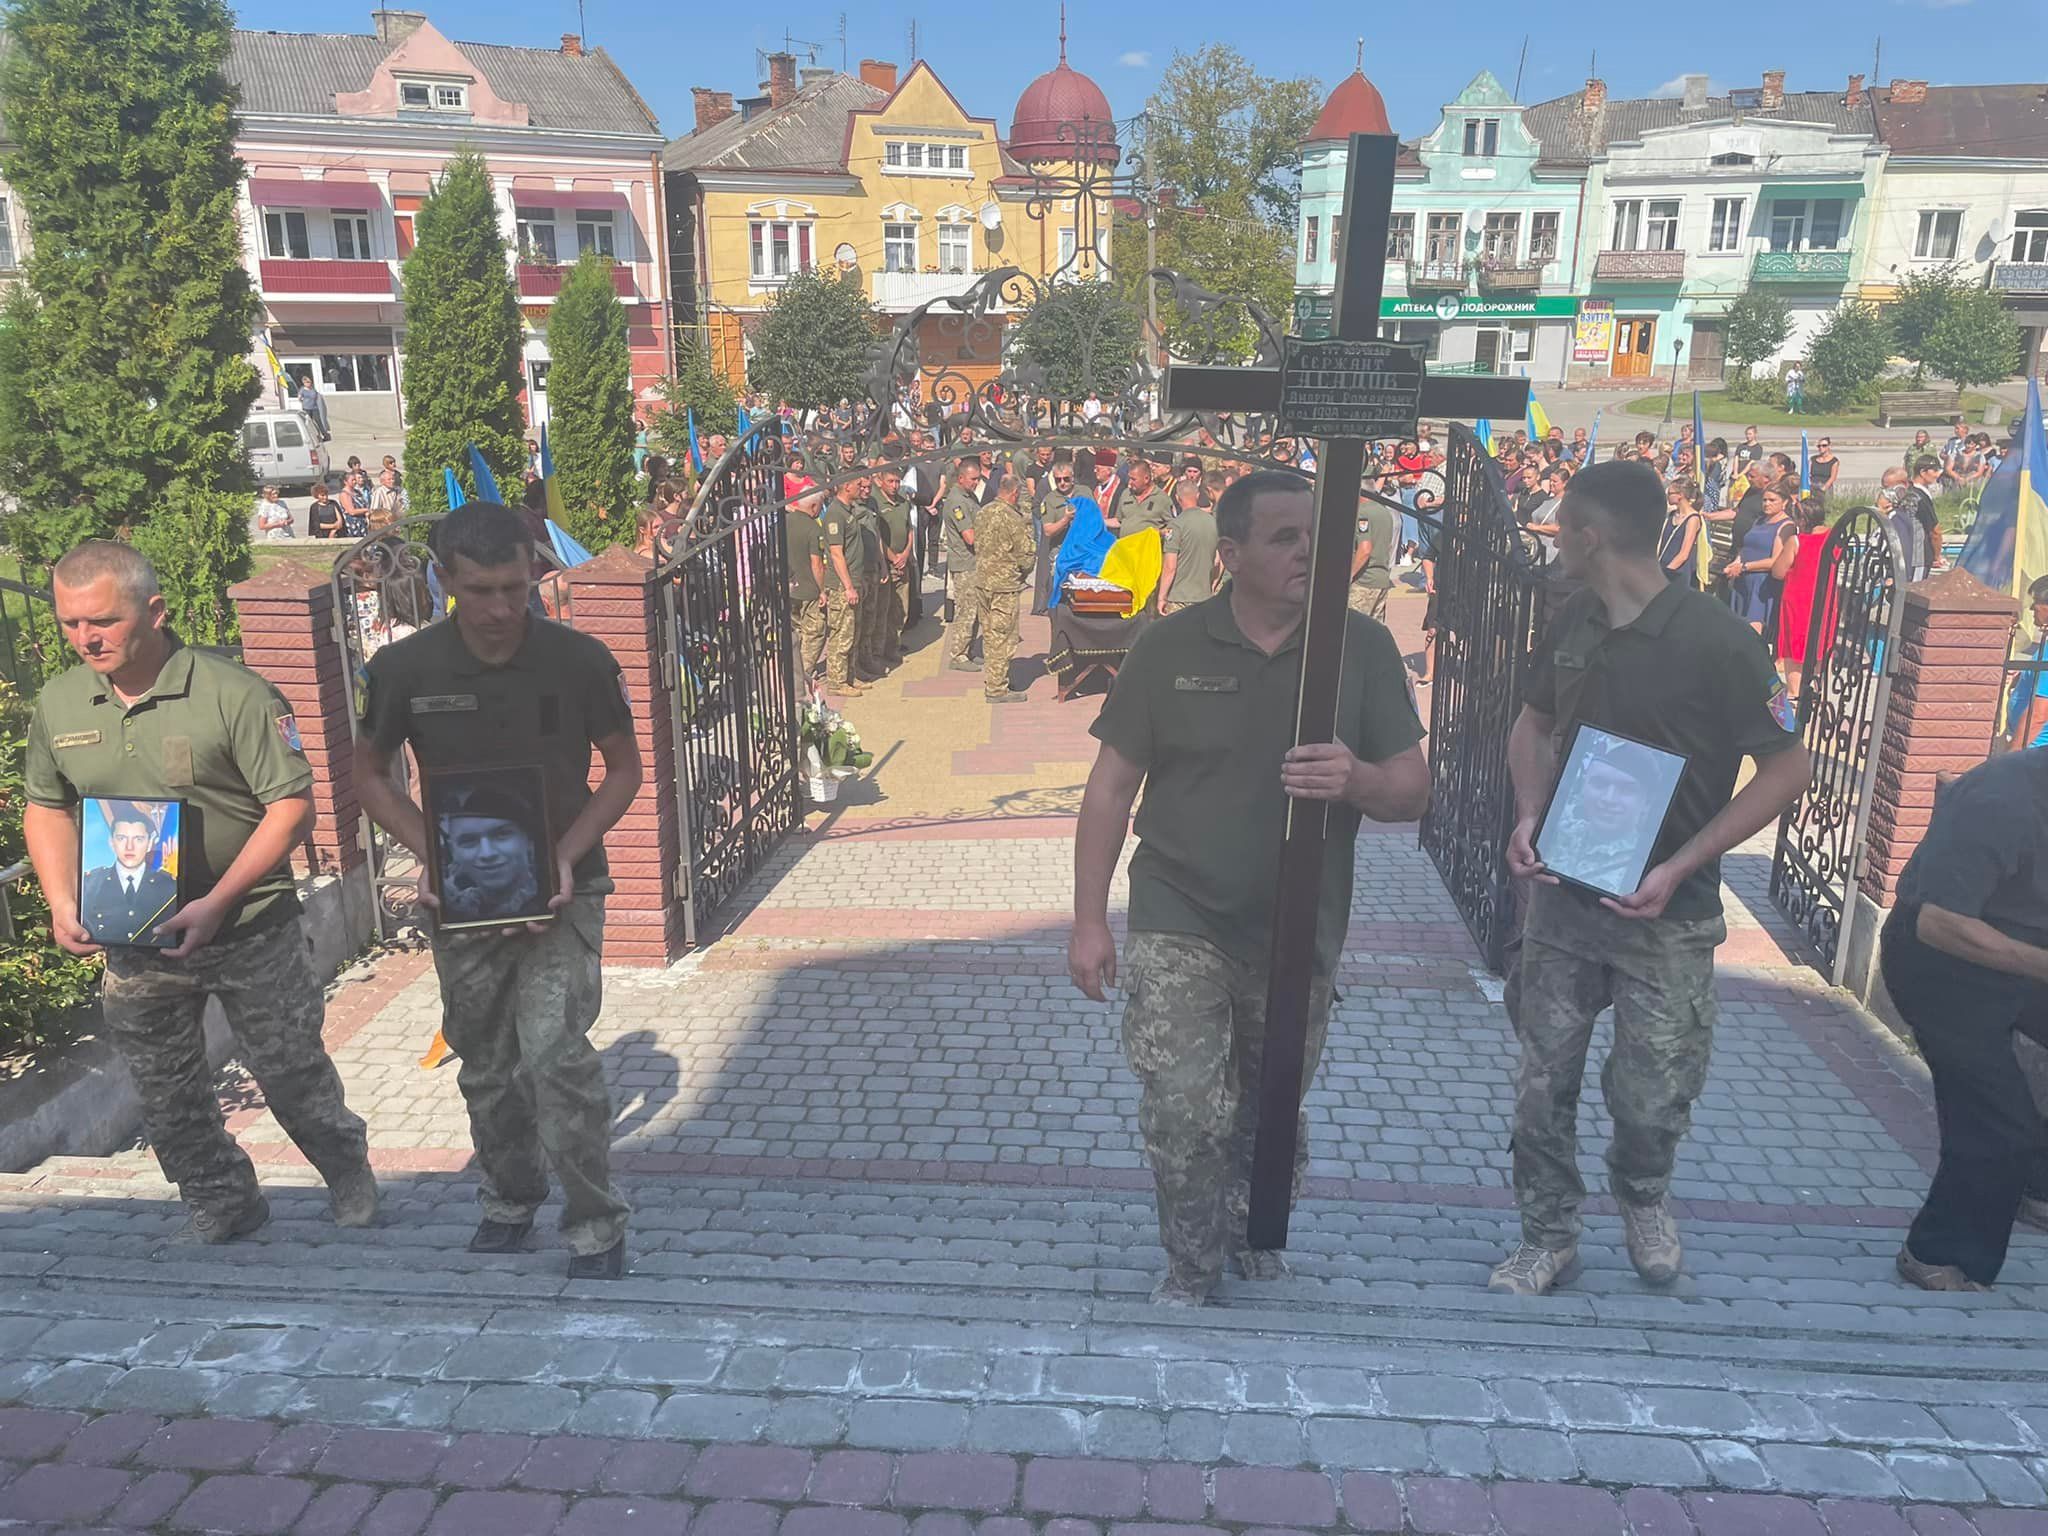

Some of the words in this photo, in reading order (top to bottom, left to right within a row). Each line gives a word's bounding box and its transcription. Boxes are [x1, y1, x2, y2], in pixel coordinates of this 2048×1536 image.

[1393, 304, 1434, 313] АПТЕКА
[1461, 303, 1536, 313] ПОДОРОЖНИК
[1580, 313, 1610, 322] ВЗУТТЯ
[1301, 355, 1385, 371] СЕРЖАНТ
